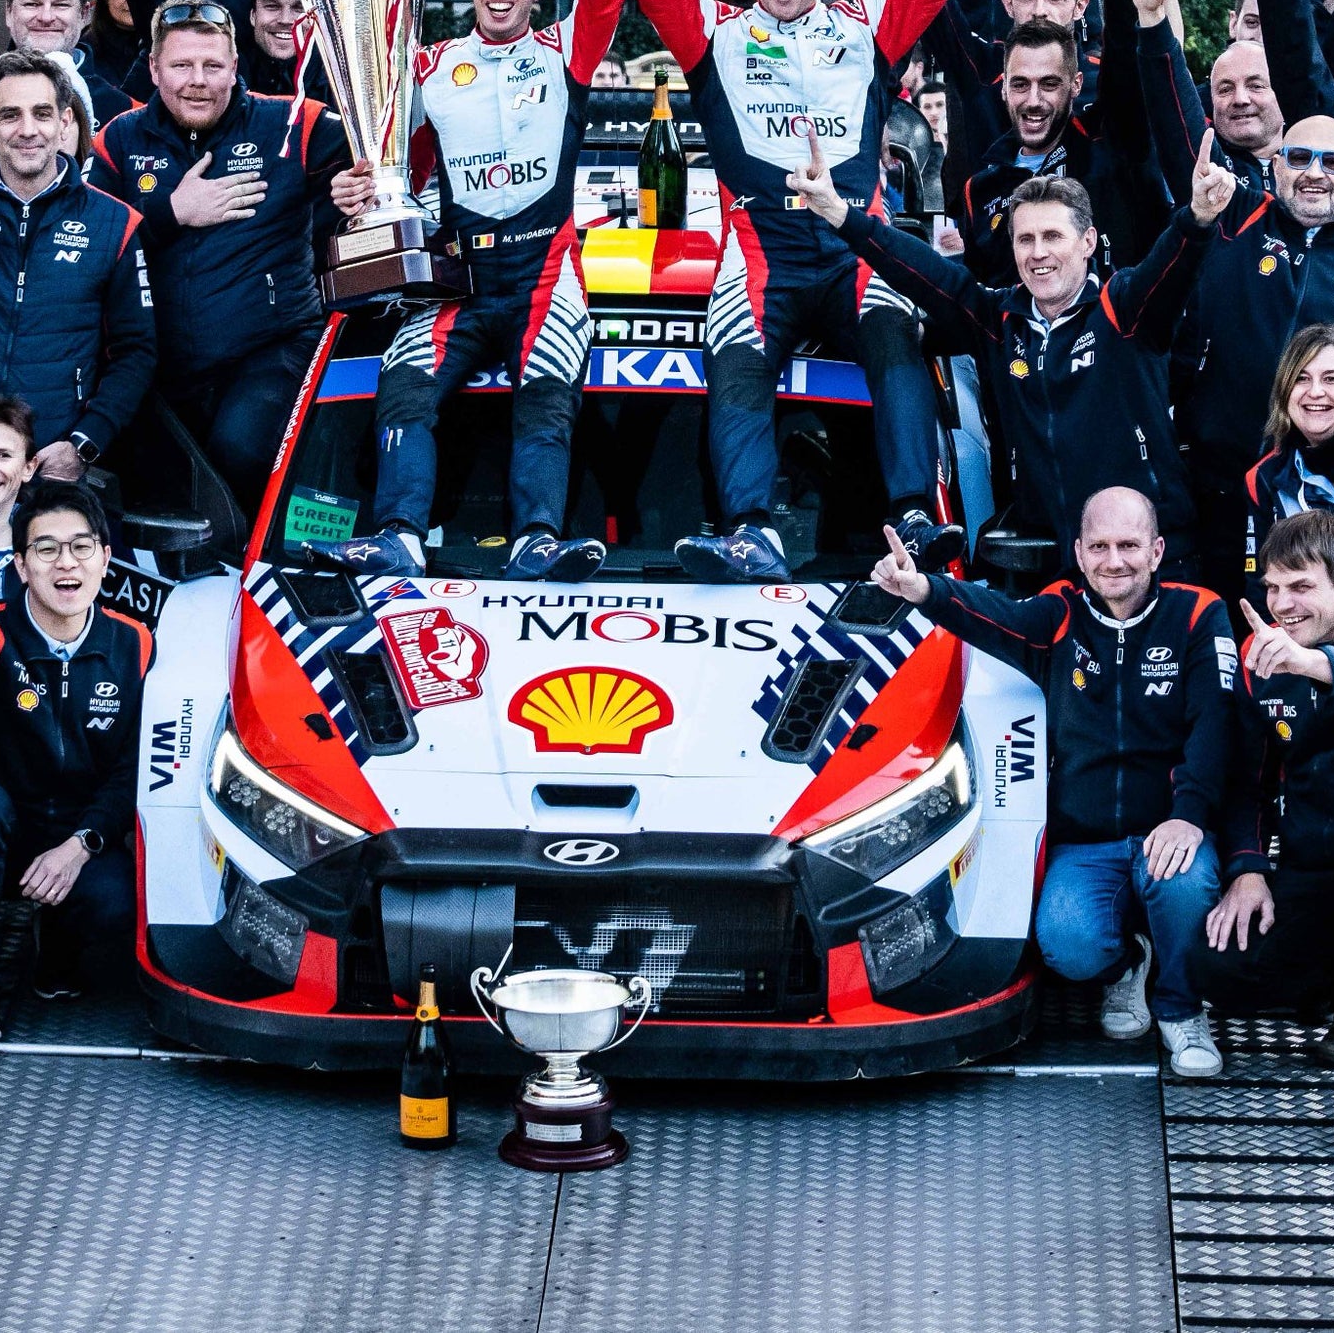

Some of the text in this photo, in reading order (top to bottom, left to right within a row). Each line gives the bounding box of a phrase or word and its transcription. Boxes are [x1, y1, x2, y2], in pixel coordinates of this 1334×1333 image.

[507, 66, 546, 83] HYUNDAI
[746, 72, 773, 81] LKQ
[746, 103, 808, 114] HYUNDAI
[766, 115, 848, 139] MOBIS
[227, 157, 264, 166] HYUNDAI
[448, 150, 507, 169] HYUNDAI
[463, 156, 548, 192] MOBIS
[54, 231, 90, 244] HYUNDAI
[293, 504, 351, 527] GREEN
[293, 523, 345, 539] LIGHT
[443, 582, 463, 594] E
[772, 586, 792, 600] E
[482, 595, 665, 610] HYUNDAI
[517, 609, 779, 652] MOBIS
[440, 639, 457, 649] 11
[1140, 662, 1179, 672] HYUNDAI
[89, 698, 121, 708] HYUNDAI
[178, 698, 194, 759] HYUNDAI
[149, 720, 178, 793] WIA
[1010, 714, 1036, 784] WIA
[994, 744, 1007, 808] HYUNDAI
